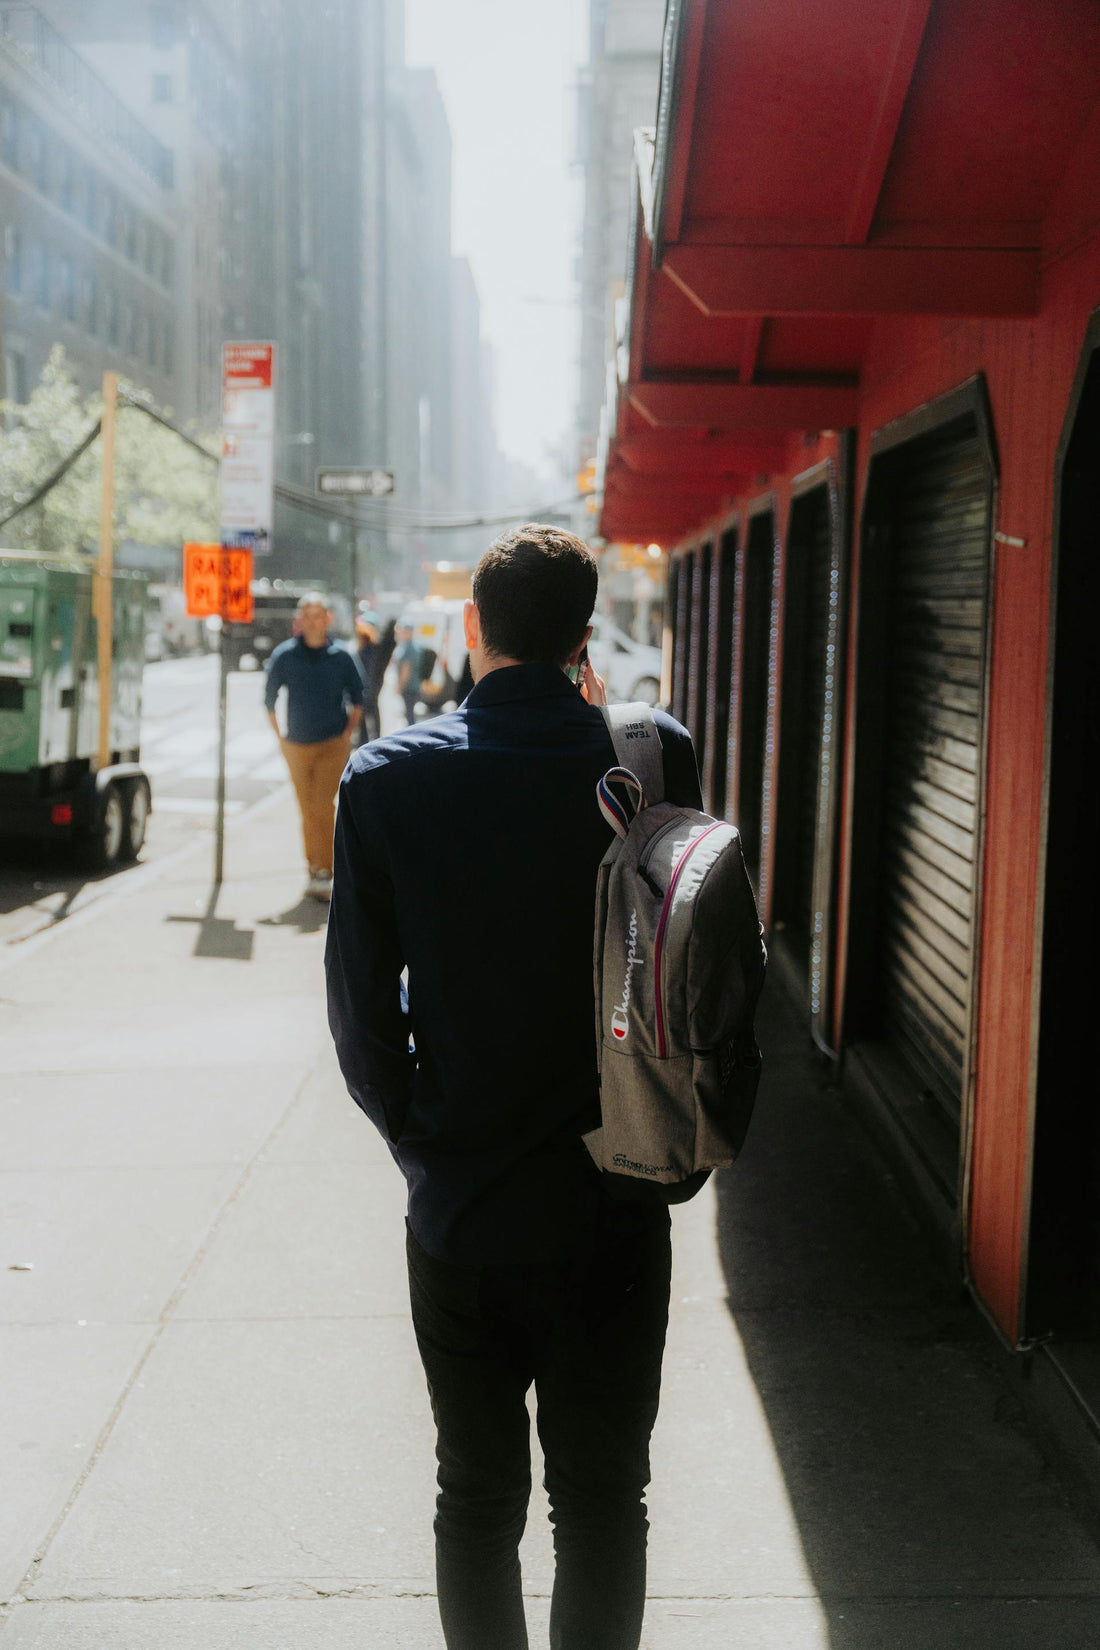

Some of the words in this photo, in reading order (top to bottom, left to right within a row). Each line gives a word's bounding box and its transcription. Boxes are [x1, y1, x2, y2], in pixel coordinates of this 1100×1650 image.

[626, 722, 645, 730] SBH
[625, 730, 651, 739] TEAM
[611, 908, 645, 1041] Champion
